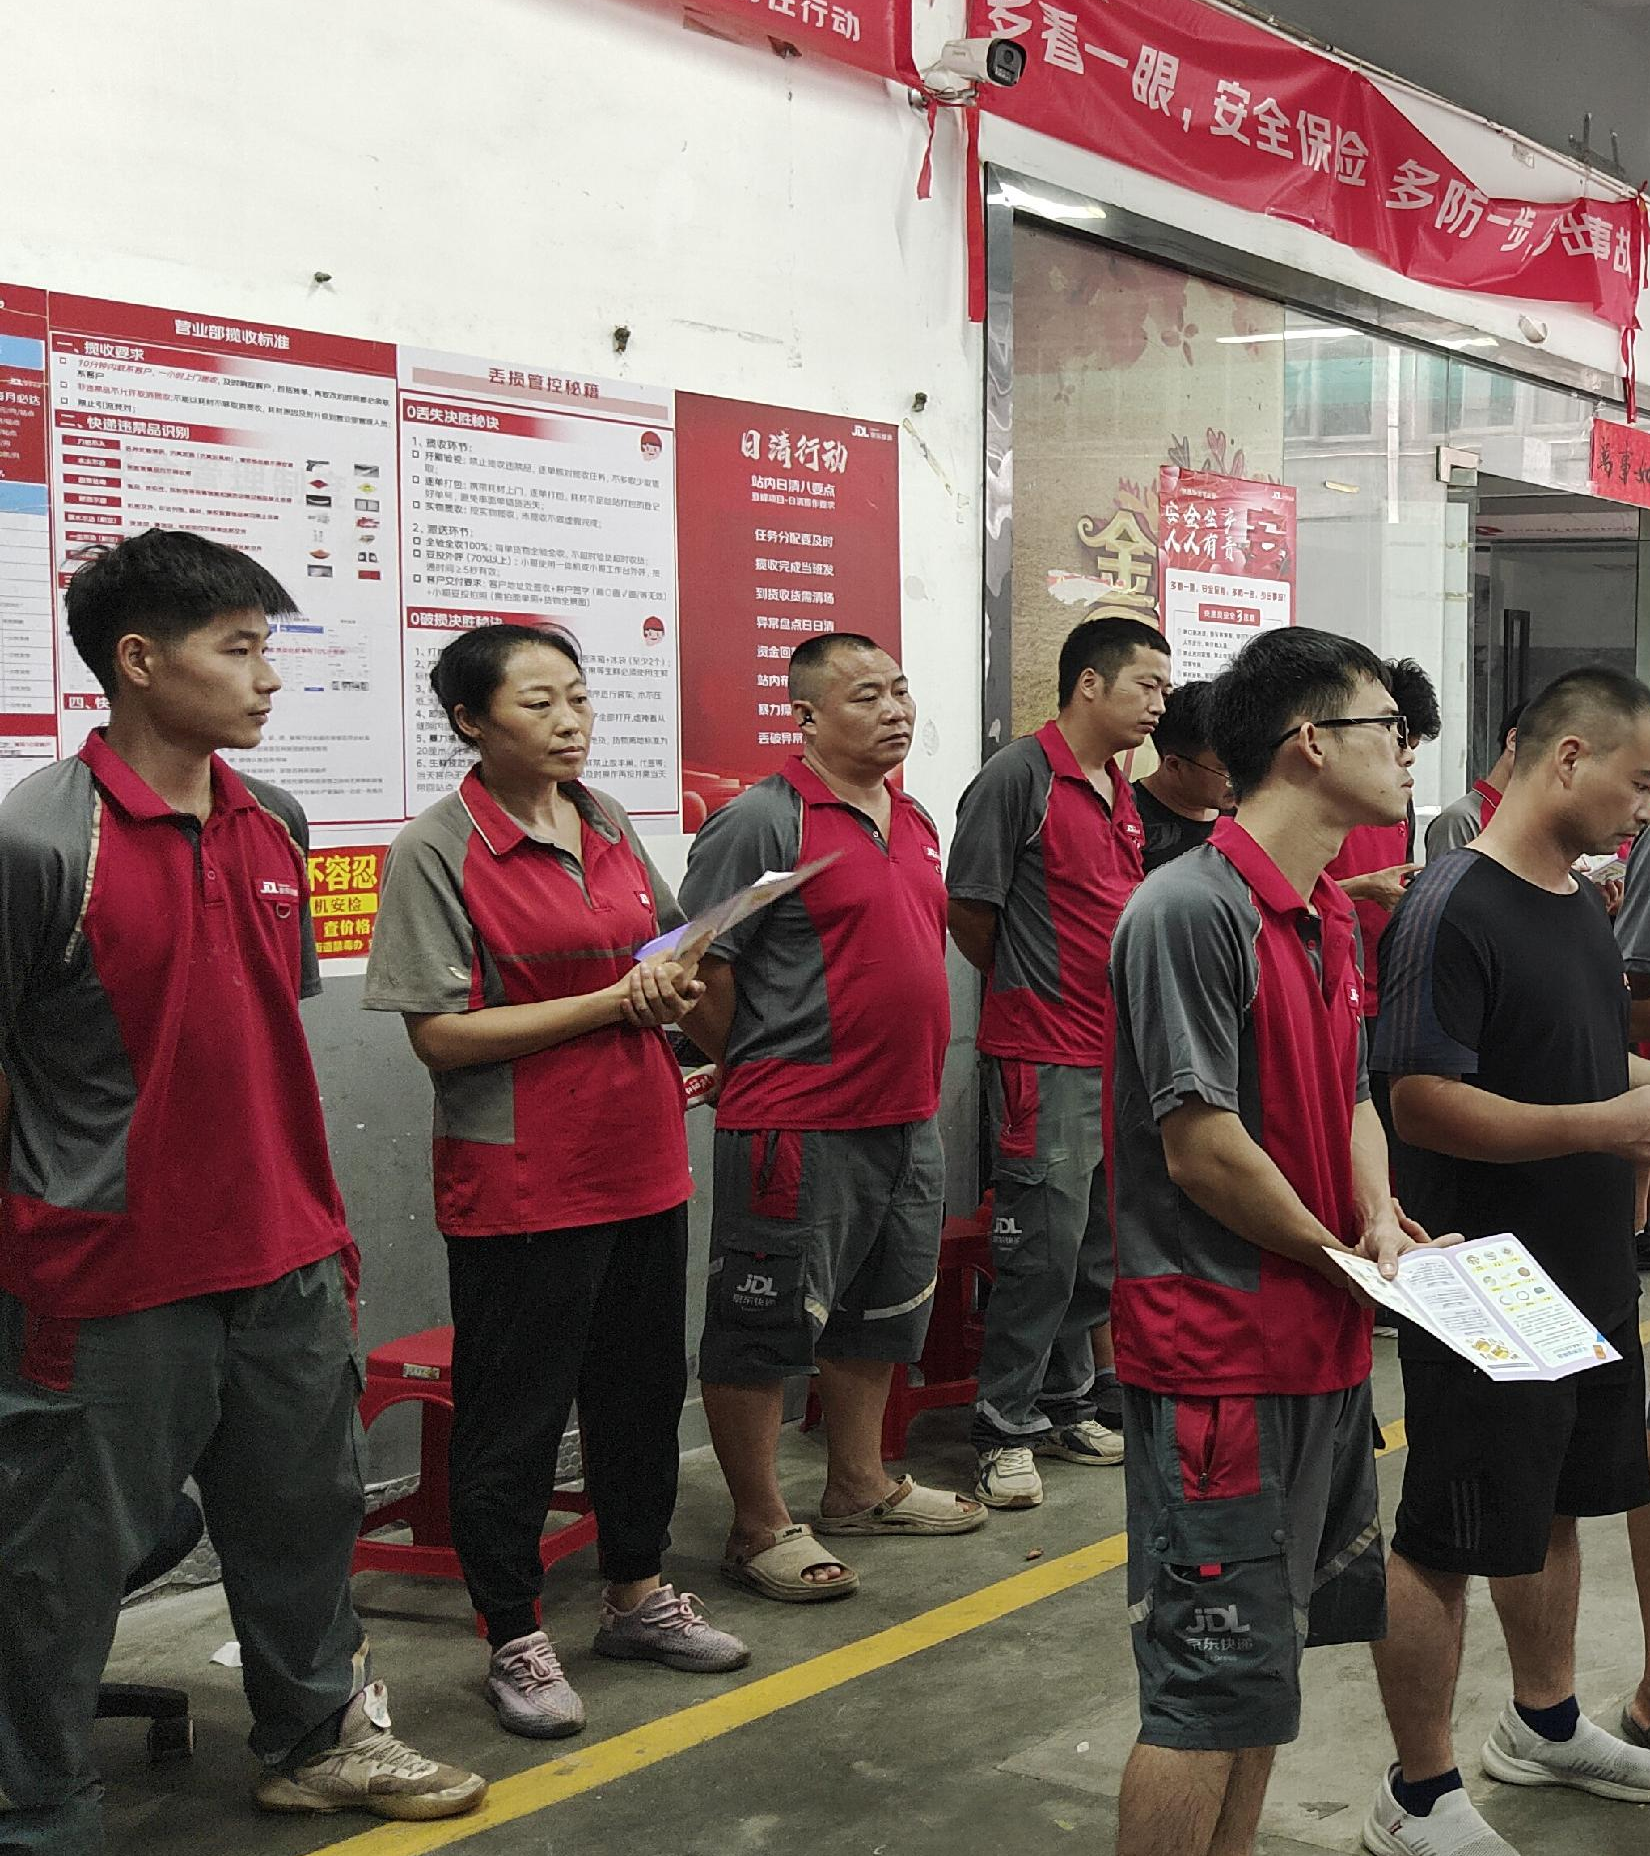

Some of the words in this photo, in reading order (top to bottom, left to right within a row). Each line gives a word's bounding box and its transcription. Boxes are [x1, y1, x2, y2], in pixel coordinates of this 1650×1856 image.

[174, 319, 290, 350] 营业部揽收标准
[489, 367, 600, 399] 丢损管控秘籍
[407, 405, 500, 431] 0丢失决胜秘诀
[741, 429, 849, 474] 日清行动
[751, 474, 836, 498] 站内日清八要点
[754, 528, 833, 547] 任务分配要及时
[757, 645, 796, 659] 资金回
[736, 1274, 778, 1297] JDL
[1186, 1604, 1250, 1634] JDL
